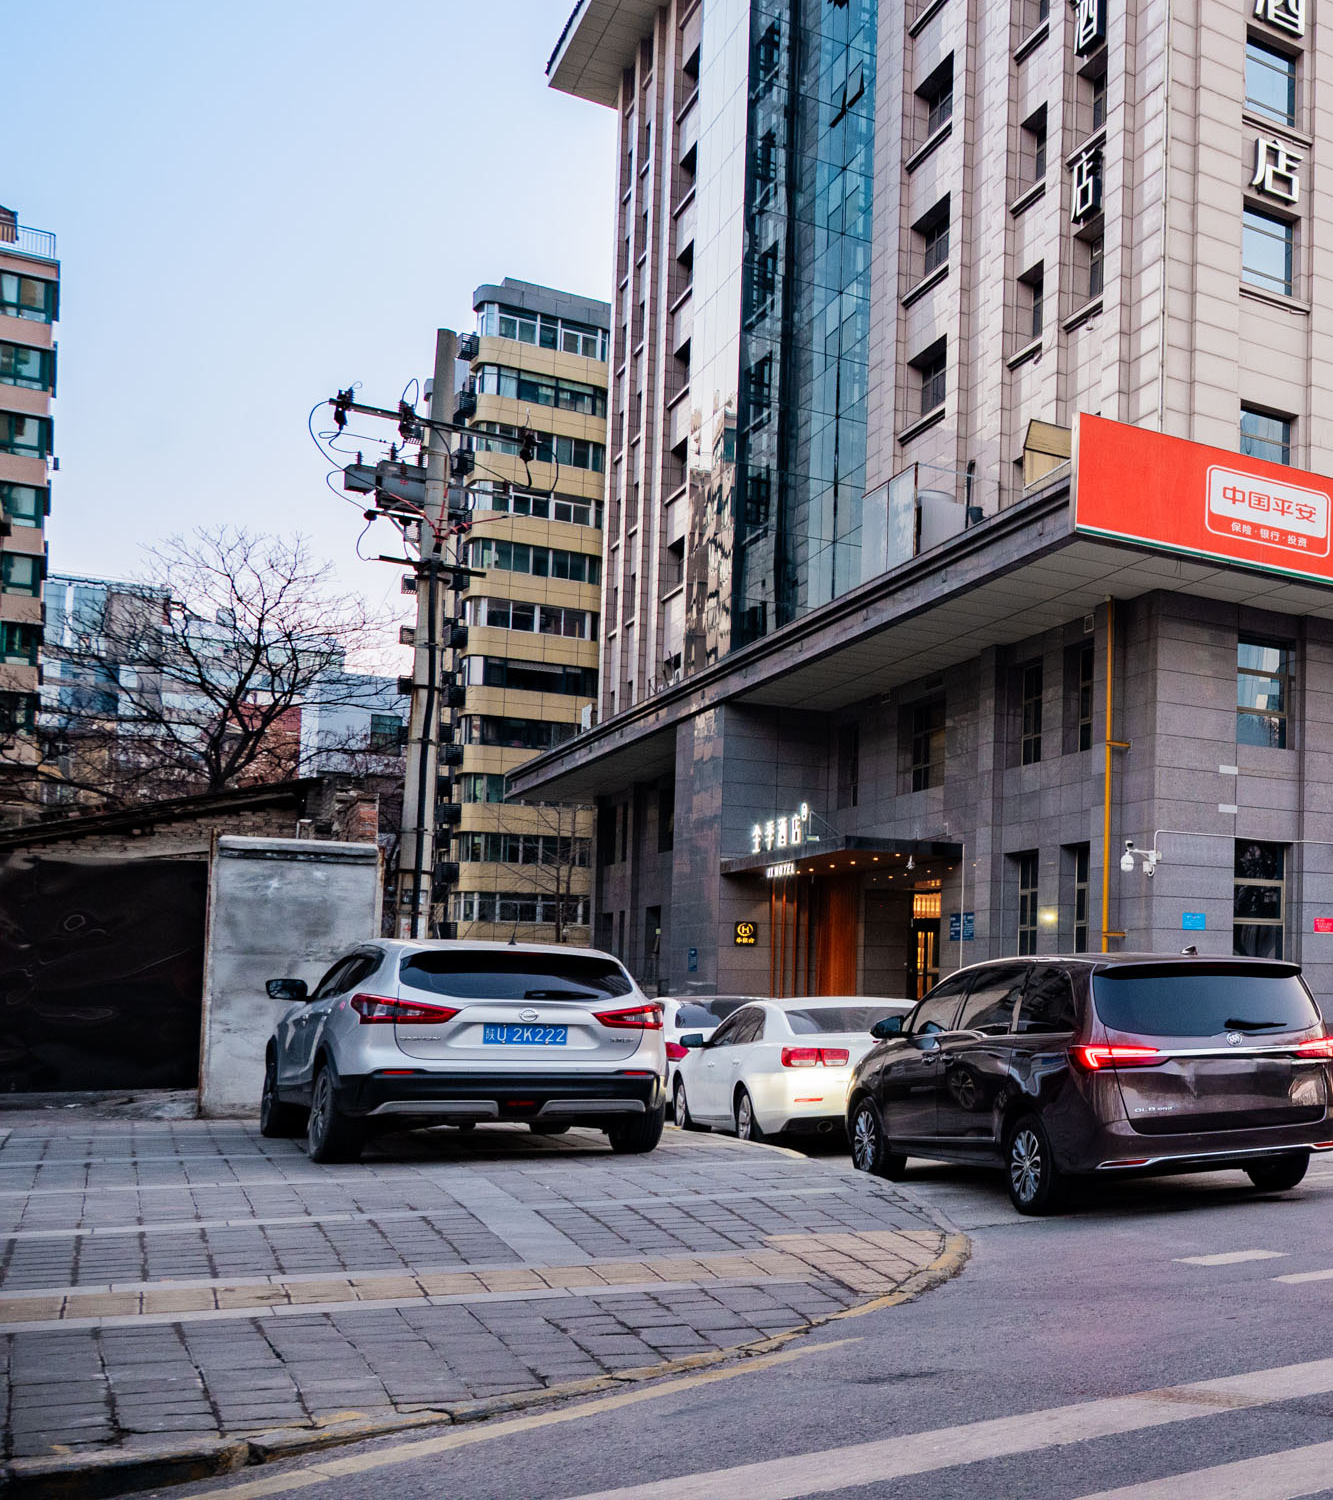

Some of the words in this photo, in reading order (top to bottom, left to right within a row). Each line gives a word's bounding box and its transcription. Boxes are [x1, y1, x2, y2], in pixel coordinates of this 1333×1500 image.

[1223, 486, 1317, 523] 中国平安
[752, 813, 802, 854] 全季酒店
[774, 862, 795, 878] HOTEL
